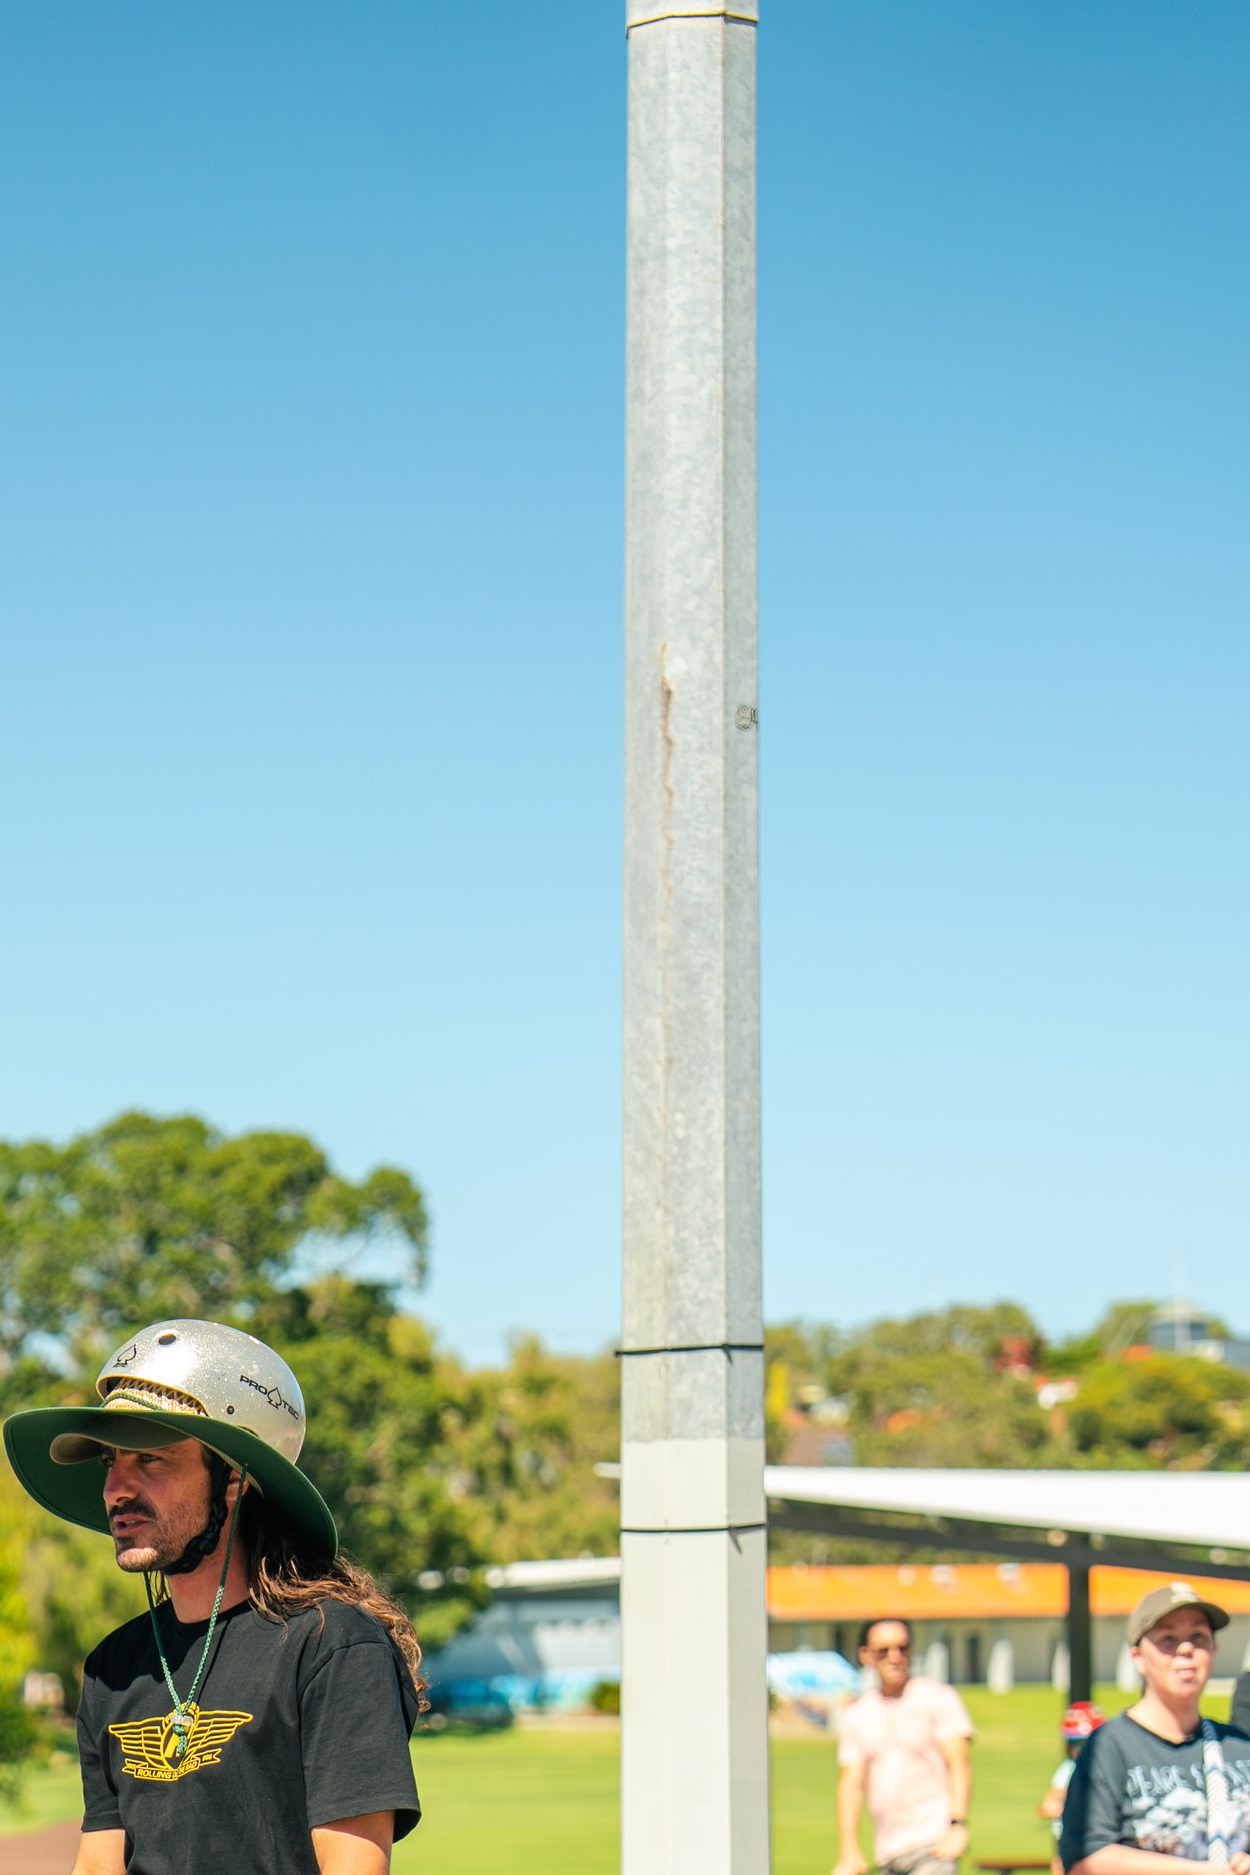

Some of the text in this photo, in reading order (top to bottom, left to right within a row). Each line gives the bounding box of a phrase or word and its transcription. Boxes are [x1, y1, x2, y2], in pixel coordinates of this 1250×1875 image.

[240, 1375, 299, 1420] PRO TEC
[137, 1769, 171, 1779] ROLLING
